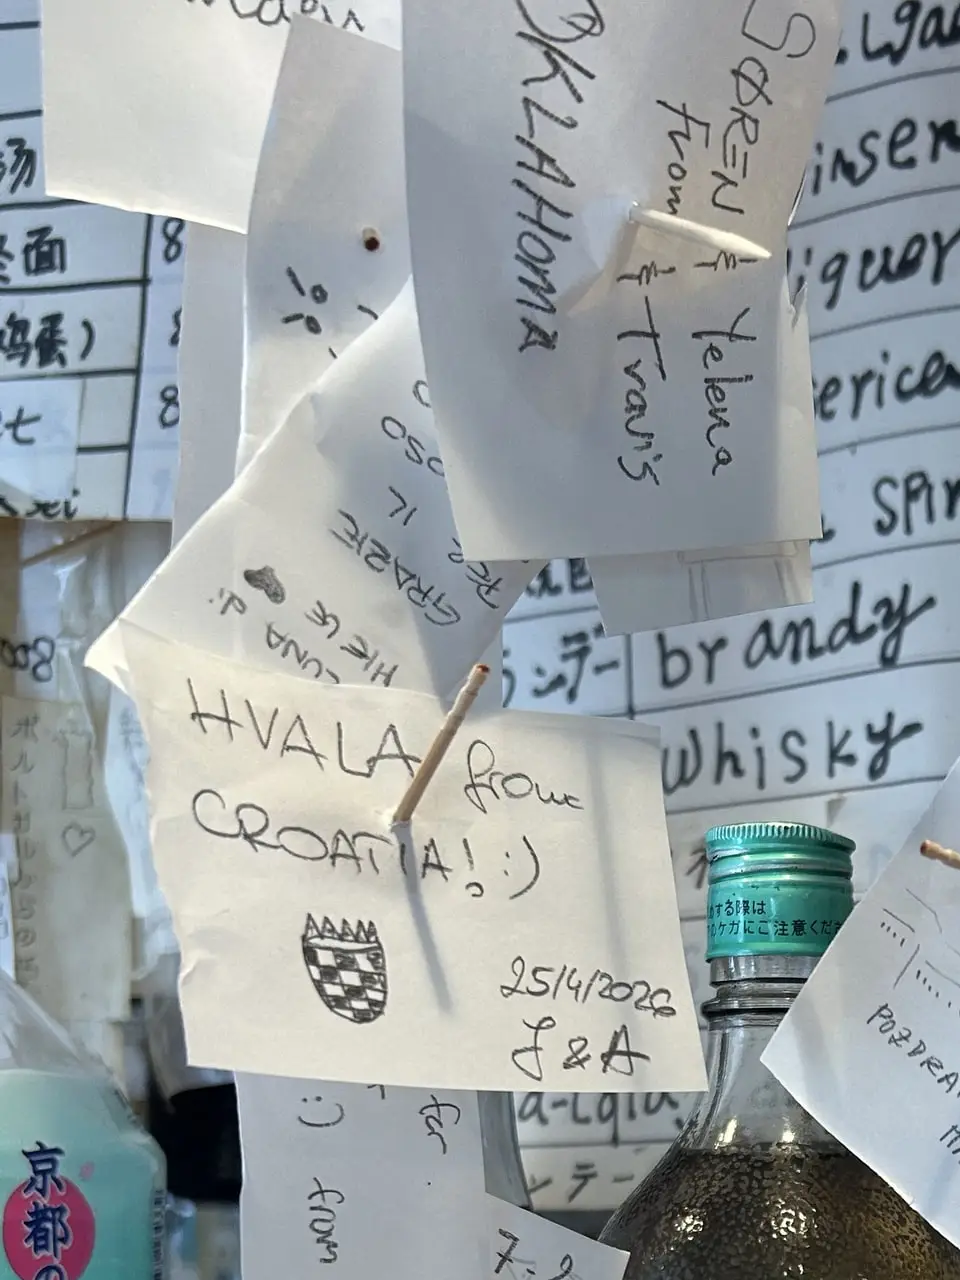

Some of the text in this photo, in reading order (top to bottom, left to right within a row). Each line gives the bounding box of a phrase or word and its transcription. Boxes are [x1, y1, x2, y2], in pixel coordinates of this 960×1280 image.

[616, 295, 668, 487] Travis
[692, 307, 757, 476] Yelena
[329, 508, 461, 628] GRAZIE
[657, 581, 936, 692] brandy
[186, 677, 422, 779] HVALA
[463, 738, 586, 816] from
[190, 787, 486, 899] CROATIA!
[499, 954, 678, 1019] 25/4/2026
[307, 1176, 346, 1265] from
